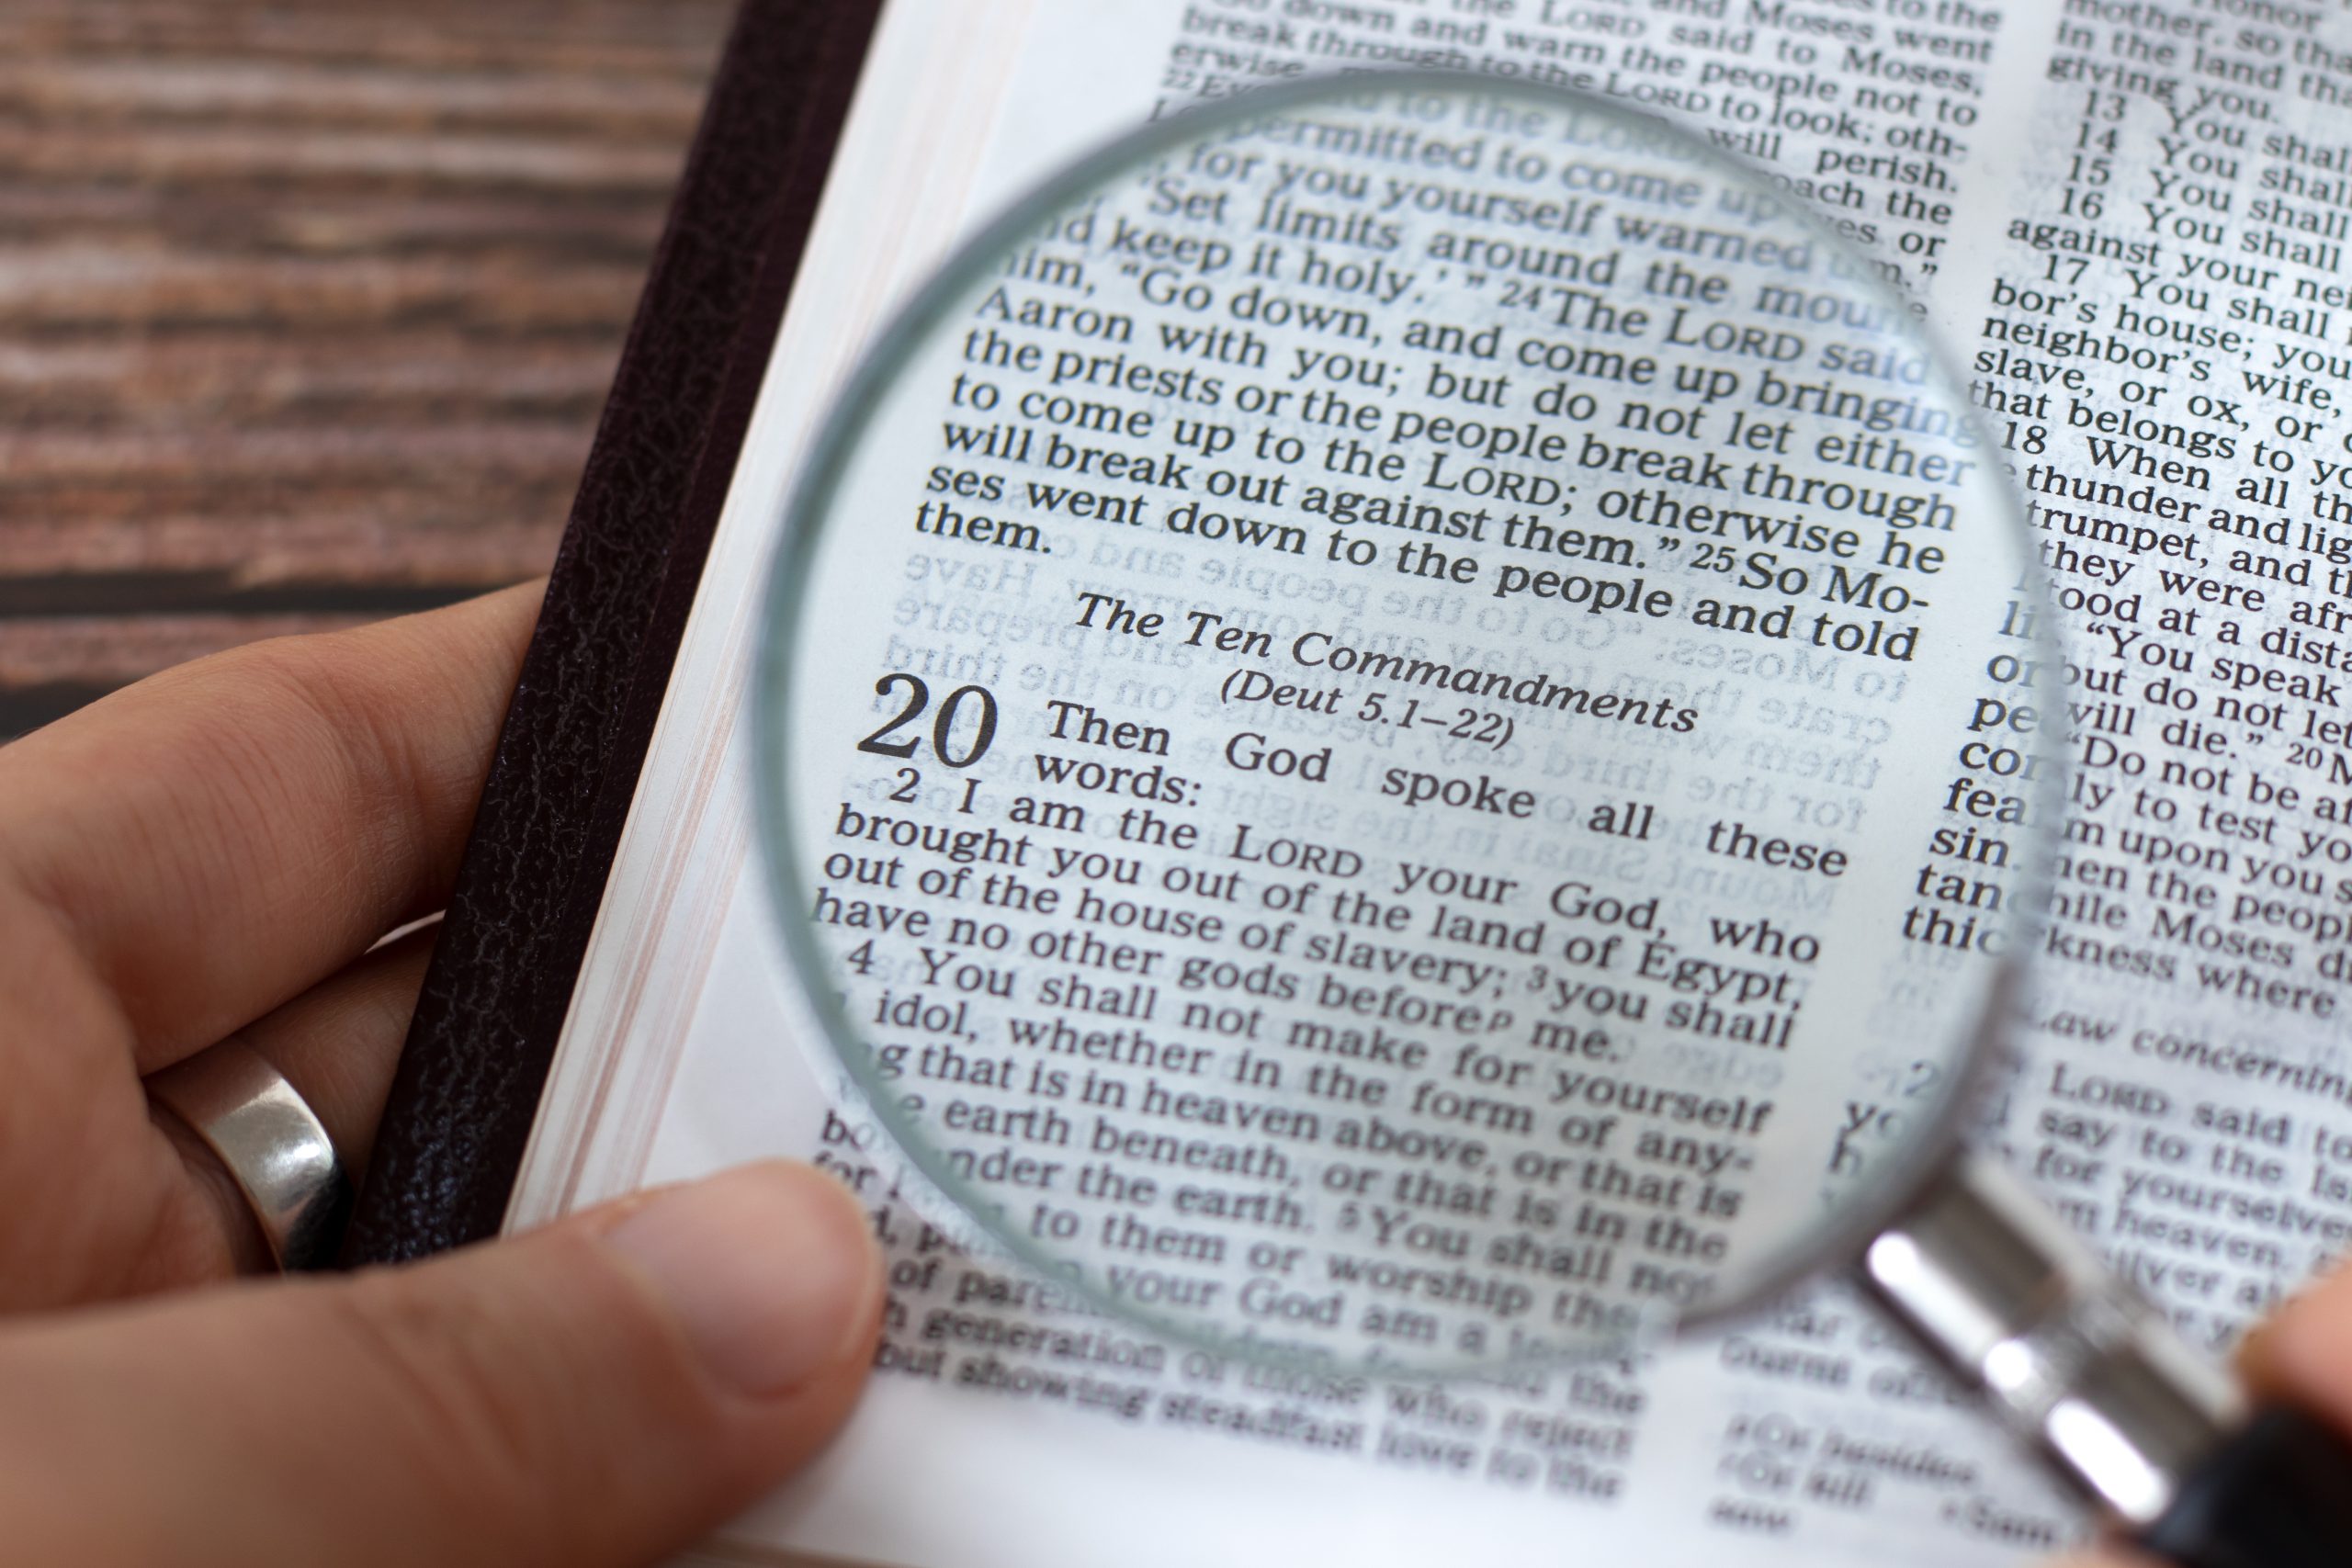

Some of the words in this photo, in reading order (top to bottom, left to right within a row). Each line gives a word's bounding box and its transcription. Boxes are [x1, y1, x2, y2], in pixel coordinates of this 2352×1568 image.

[1182, 6, 1295, 50] break
[1668, 22, 1756, 54] said
[1777, 36, 1818, 64] to
[1841, 47, 1982, 97] Moses,
[1745, 0, 1873, 41] Moses
[1893, 28, 1993, 62] went
[1700, 59, 1838, 103] people
[1853, 85, 1921, 118] not
[1936, 96, 1978, 127] to
[1770, 100, 1873, 143] look;
[1885, 122, 1967, 157] oth-
[1815, 148, 1958, 194] perish.
[2075, 123, 2119, 153] 14
[2157, 136, 2240, 179] You
[2061, 188, 2104, 220] 16
[2142, 203, 2223, 245] You
[2241, 231, 2341, 273] shall
[2068, 155, 2111, 185] 15
[2150, 169, 2232, 212] You
[2248, 199, 2348, 241] shall
[2007, 219, 2162, 267] against
[2179, 253, 2278, 290] your
[1121, 261, 1212, 311] “Go
[1229, 286, 1382, 347] down,
[1403, 317, 1501, 361] and
[1517, 337, 1657, 385] come
[1674, 363, 1740, 401] up
[1991, 278, 2098, 323] bor’s
[2116, 304, 2254, 361] house;
[2044, 254, 2090, 286] 17
[2125, 268, 2211, 311] You
[2227, 298, 2329, 339] shall
[977, 286, 1132, 344] Aaron
[1159, 322, 1267, 367] with
[1290, 348, 1403, 395] you;
[1427, 364, 1510, 409] but
[1534, 381, 1596, 422] do
[1617, 402, 1705, 438] not
[1725, 412, 1793, 454] let
[1815, 432, 1975, 487] either
[1974, 347, 2094, 398] slave,
[2120, 381, 2167, 407] or
[2188, 396, 2250, 431] ox,
[2275, 415, 2323, 445] or
[1982, 316, 2211, 381] neighbor’s
[2244, 371, 2341, 418] wife,
[964, 329, 1042, 372] the
[1050, 350, 1222, 405] priests
[1235, 384, 1291, 417] or
[1302, 388, 1382, 430] the
[1390, 411, 1566, 460] people
[1578, 433, 1734, 491] break
[1745, 461, 1957, 531] through
[2001, 422, 2047, 455] 18
[2086, 436, 2211, 491] When
[2235, 477, 2290, 509] all
[2068, 400, 2235, 458] belongs
[2253, 442, 2294, 473] to
[951, 374, 1000, 411] to
[1020, 391, 1153, 436] come
[1174, 419, 1235, 457] up
[1256, 429, 1304, 463] to
[1325, 437, 1405, 480] the
[1423, 451, 1578, 516] LORD;
[1598, 488, 1859, 557] otherwise
[1880, 532, 1945, 574] he
[2026, 463, 2202, 523] thunder
[2209, 507, 2290, 545] and
[916, 500, 1051, 553] them.
[944, 423, 1032, 460] will
[1047, 434, 1193, 490] break
[1205, 470, 1288, 505] out
[1301, 486, 1491, 542] against
[1822, 566, 1929, 613] Mo-
[2026, 500, 2209, 566] trumpet,
[2229, 551, 2311, 587] and
[927, 464, 1005, 499] ses
[1027, 480, 1147, 526] went
[1166, 502, 1306, 553] down
[1328, 531, 1376, 566] to
[1396, 542, 1478, 582] the
[1494, 563, 1672, 616] people
[1692, 599, 1796, 638] and
[1812, 613, 1919, 661] told
[2039, 539, 2135, 586] they
[2159, 570, 2265, 612] were
[1076, 592, 1164, 638] The
[1187, 611, 1272, 657] Ten
[1291, 631, 1699, 733] Commandments
[2087, 623, 2193, 672] “You
[2211, 656, 2339, 707] speak
[2159, 606, 2201, 636] at
[2218, 621, 2239, 644] a
[1221, 669, 1343, 716] (Deut
[2143, 679, 2197, 711] do
[2216, 694, 2288, 730] not
[857, 673, 998, 768] 20
[1047, 700, 1170, 756] Then
[1225, 732, 1332, 782] God
[1381, 767, 1536, 818] spoke
[1589, 803, 1654, 840] all
[1706, 818, 1848, 876] these
[1035, 754, 1202, 807] words:
[2161, 758, 2231, 795] not
[2248, 775, 2298, 809] be
[2135, 789, 2177, 821] to
[2199, 804, 2276, 845] test
[890, 768, 920, 804] 2
[958, 778, 982, 813] I
[1010, 797, 1084, 831] am
[1120, 807, 1197, 850] the
[1229, 824, 1363, 877] LORD
[1394, 862, 1518, 905] your
[1550, 881, 1668, 939] God,
[1709, 918, 1819, 964] who
[2120, 829, 2229, 873] upon
[2242, 856, 2324, 895] you
[2146, 870, 2217, 908] the
[835, 803, 1033, 867] brought
[1047, 847, 1140, 883] you
[1162, 867, 1241, 902] out
[1261, 882, 1319, 915] of
[1332, 892, 1411, 932] the
[1429, 906, 1546, 955] land
[1565, 935, 1621, 969] of
[1636, 939, 1801, 1010] Egypt,
[2152, 909, 2293, 967] Moses
[816, 887, 930, 937] have
[948, 917, 1010, 950] no
[1029, 931, 1162, 975] other
[1178, 955, 1298, 1000] gods
[1531, 1019, 1620, 1062] me.
[825, 853, 904, 887] out
[920, 867, 973, 898] of
[983, 875, 1060, 913] the
[1075, 889, 1223, 942] house
[1240, 923, 1294, 953] of
[1305, 929, 1508, 998] slavery;
[1666, 995, 1801, 1049] shall
[2197, 964, 2335, 1019] where
[874, 997, 978, 1043] idol,
[945, 1095, 1071, 1145] earth
[1091, 1119, 1300, 1186] beneath,
[1140, 1078, 1322, 1141] heaven
[1334, 1117, 1498, 1175] above,
[2051, 1062, 2170, 1116] LORD
[2193, 1103, 2290, 1146] said
[1240, 1281, 1342, 1325] God
